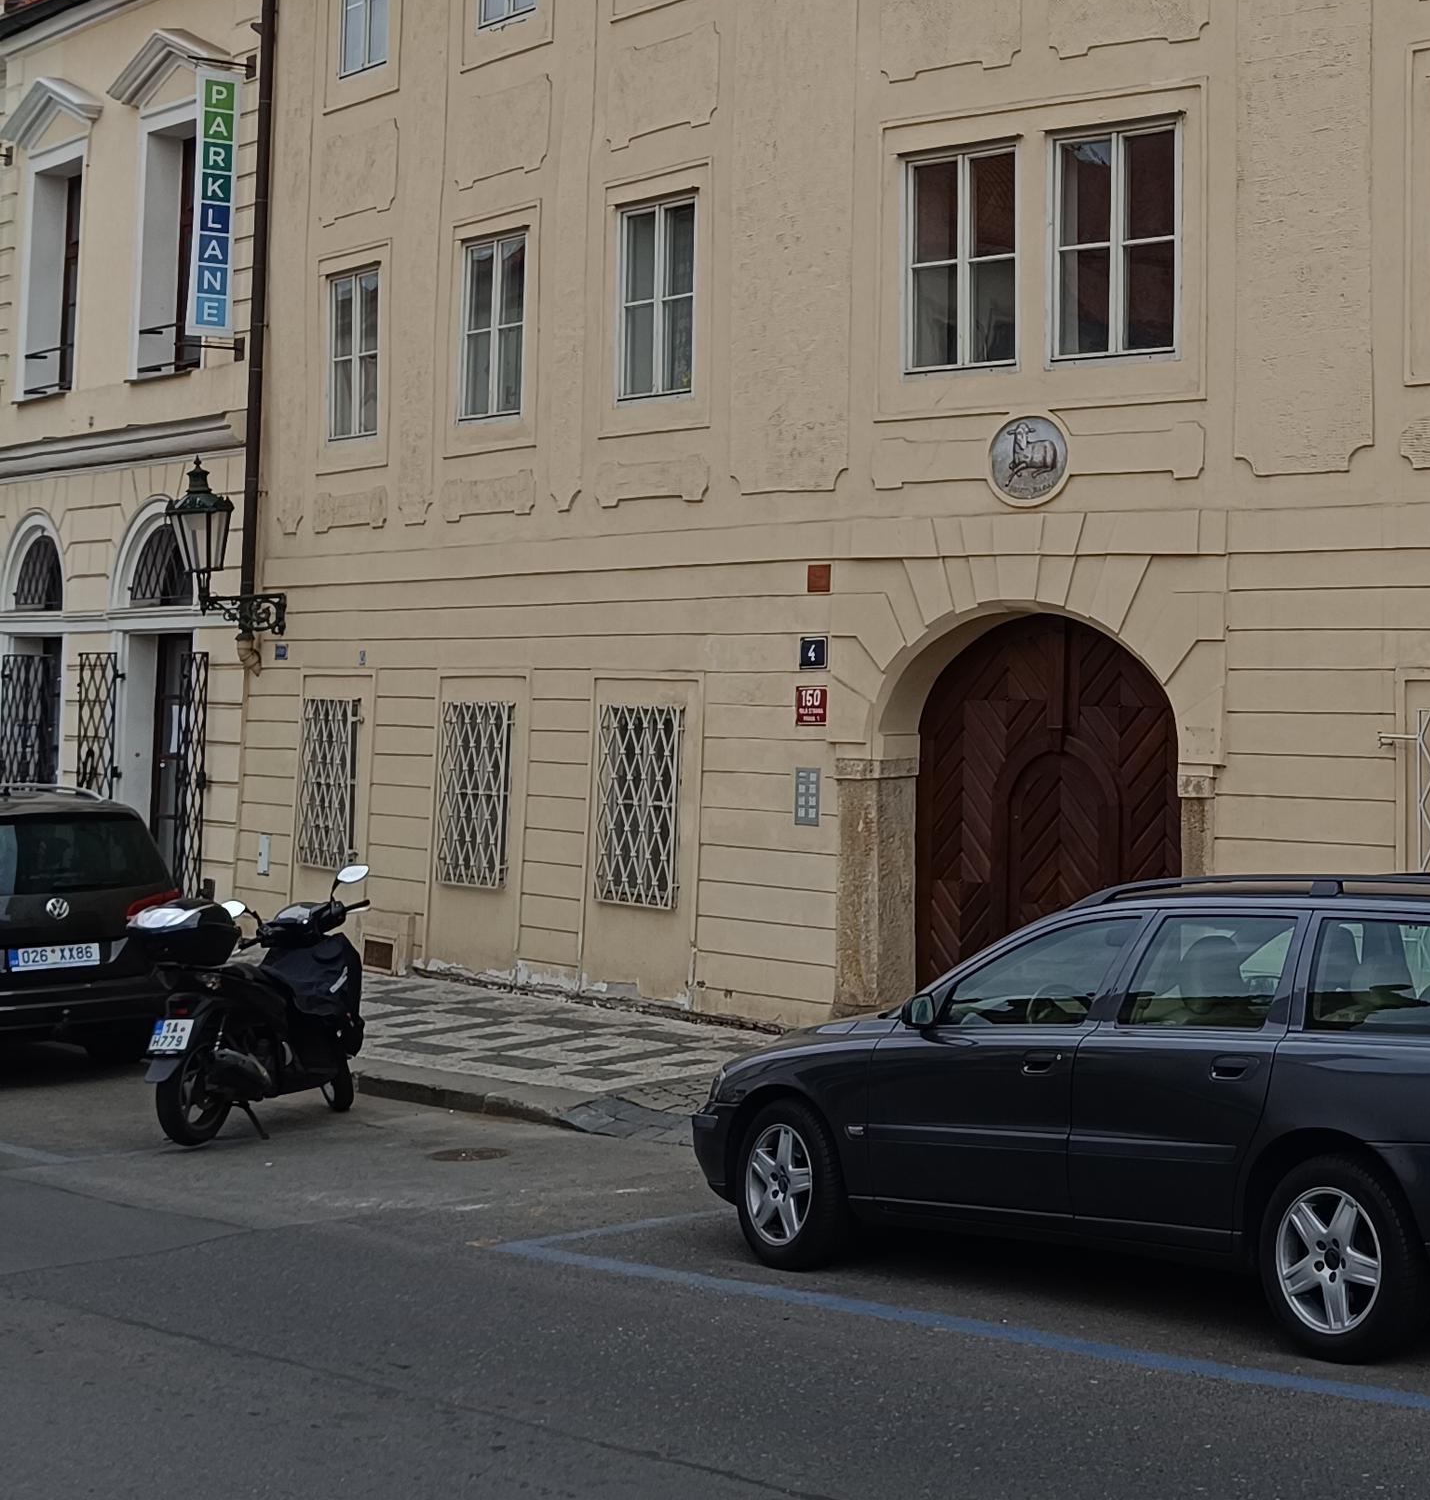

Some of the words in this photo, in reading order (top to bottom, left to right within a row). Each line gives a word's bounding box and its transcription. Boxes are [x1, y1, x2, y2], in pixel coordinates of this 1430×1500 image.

[808, 644, 816, 661] 4
[801, 690, 821, 706] 150
[22, 949, 48, 964] 026
[60, 946, 92, 961] XX86
[166, 1022, 178, 1034] 1A
